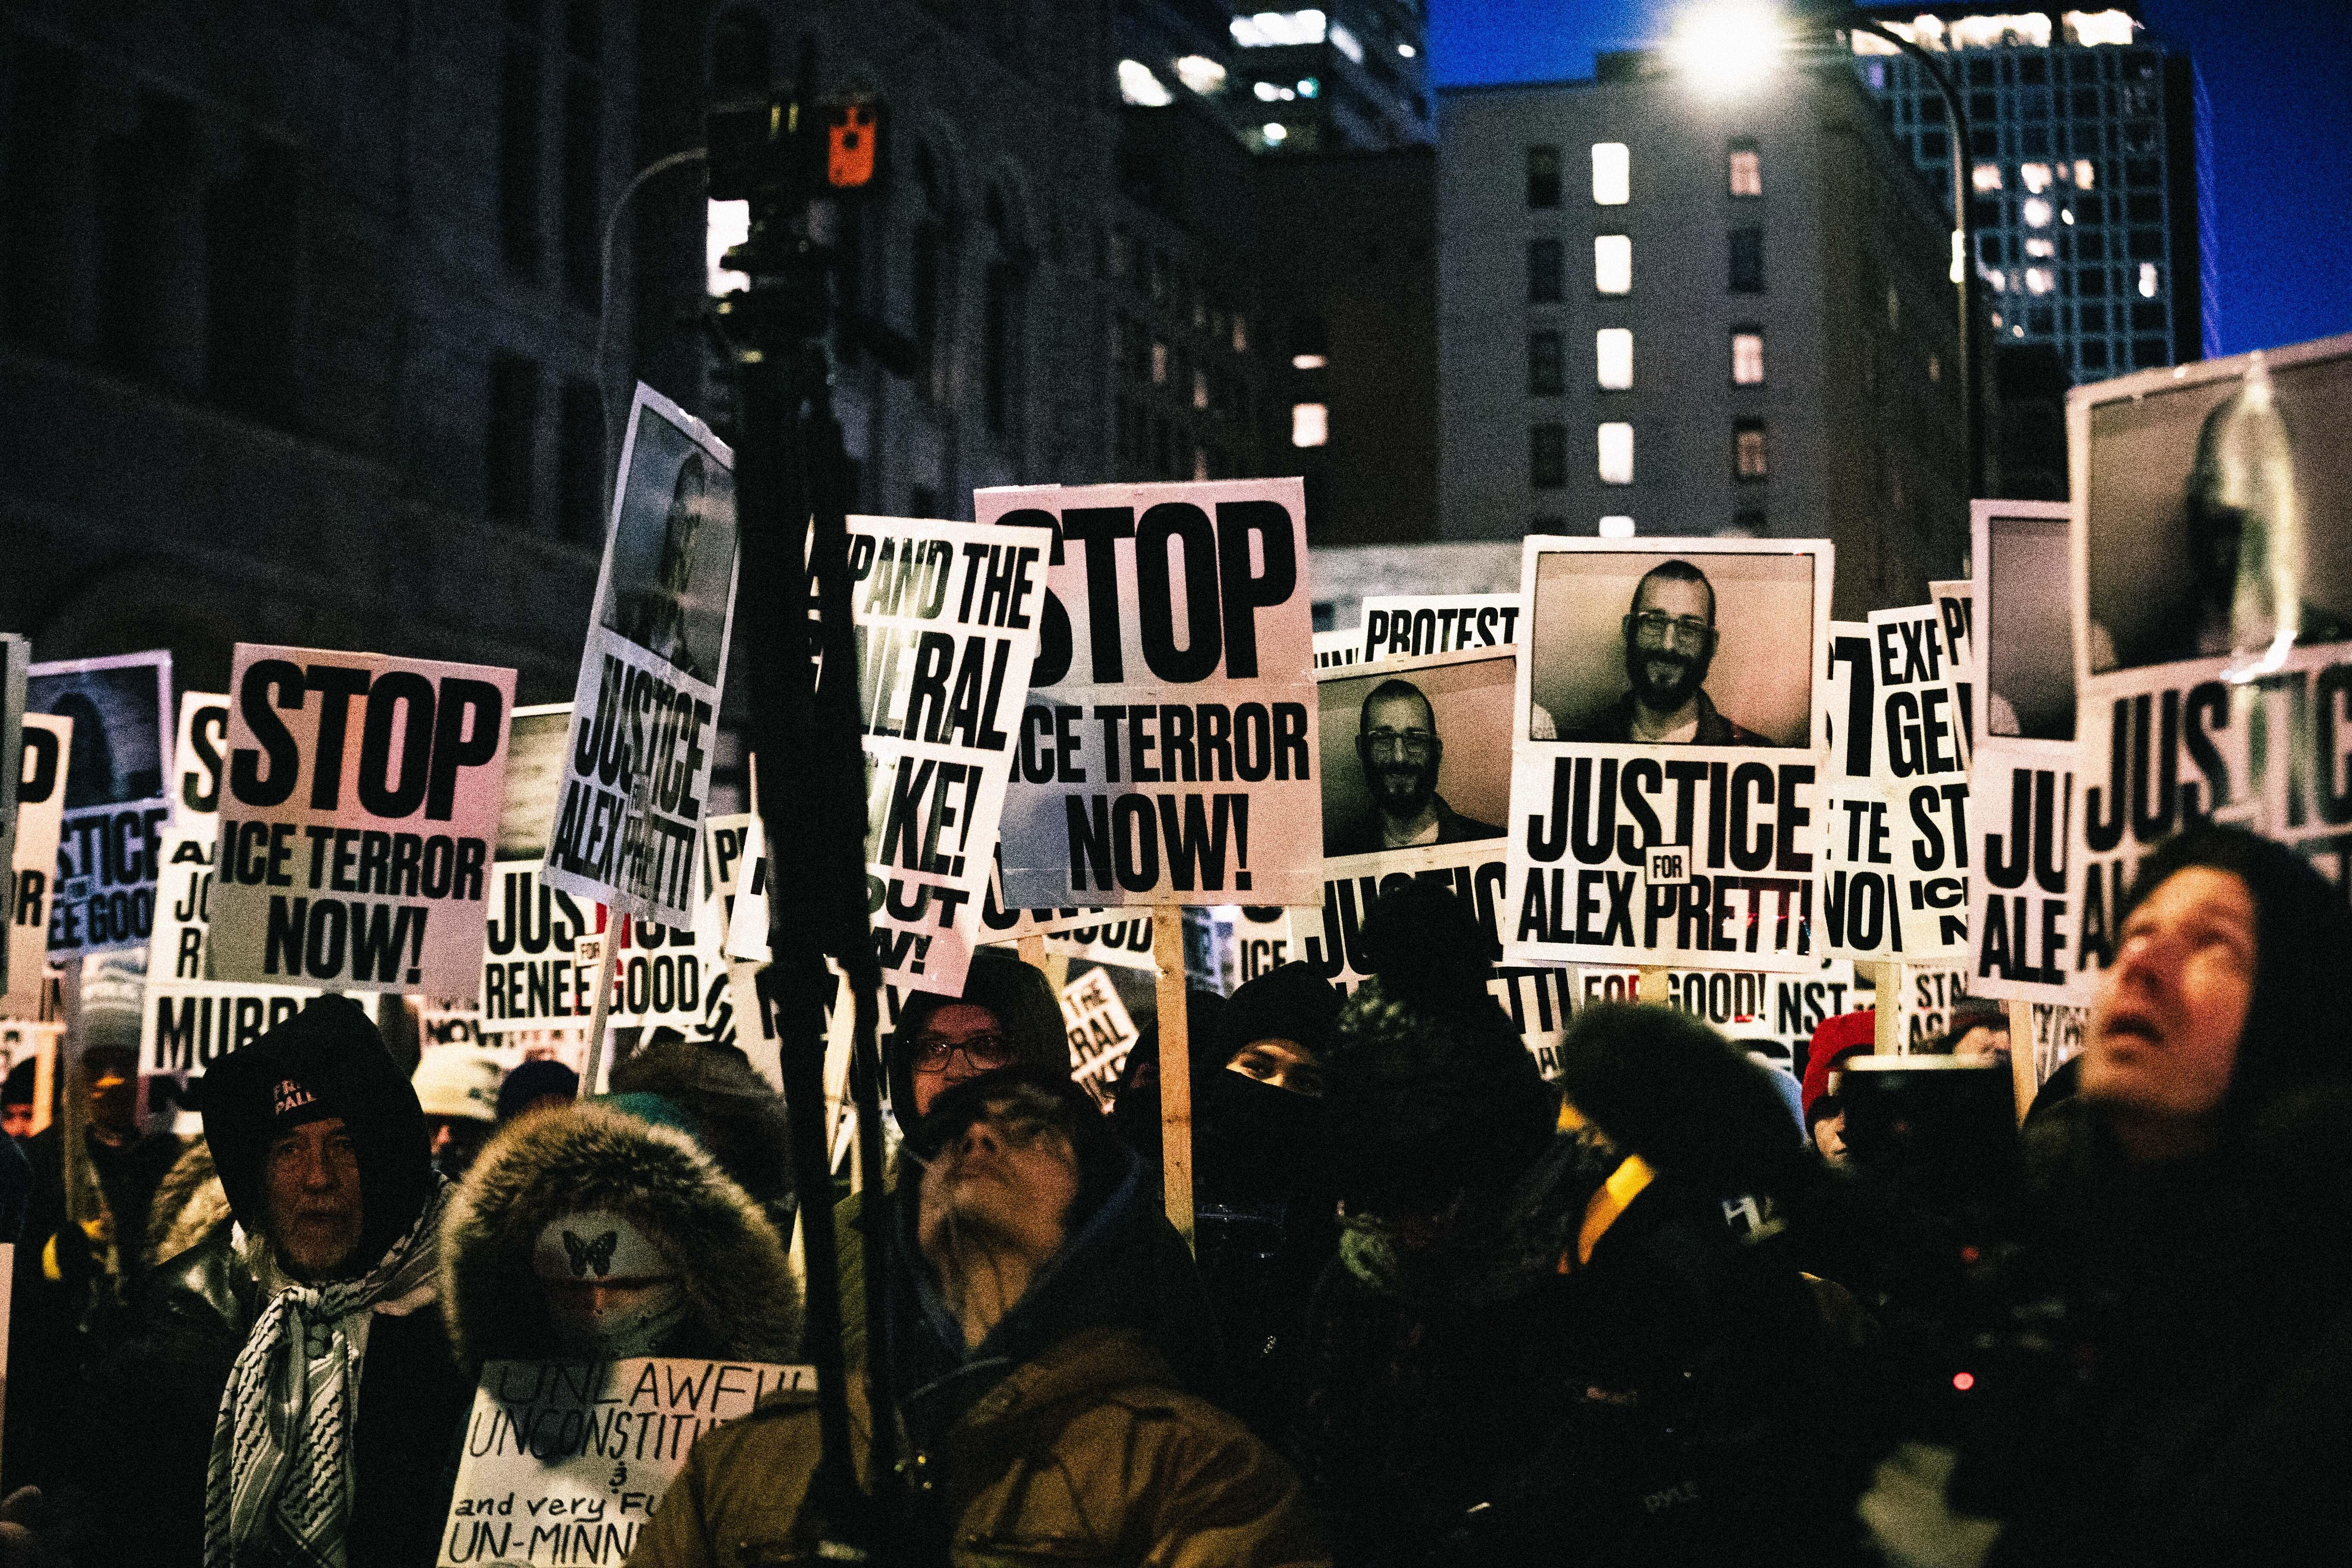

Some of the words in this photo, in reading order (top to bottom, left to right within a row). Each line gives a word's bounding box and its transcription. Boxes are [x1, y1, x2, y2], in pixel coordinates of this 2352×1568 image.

[846, 534, 953, 619] PAND
[958, 542, 1040, 630] THE
[1365, 607, 1519, 662] PROTEST
[230, 659, 502, 821] STOP
[575, 653, 713, 822] JUSTICE
[1008, 704, 1087, 784] CE
[1093, 702, 1310, 784] TERROR
[550, 779, 626, 888] ALEX
[1065, 793, 1253, 894] NOW!
[1526, 756, 1815, 873] JUSTICE
[220, 820, 297, 887] ICE
[306, 825, 487, 901] TERROR
[1652, 854, 1682, 879] FOR
[264, 895, 429, 985] NOW!
[1517, 867, 1636, 946] ALEX
[1643, 874, 1813, 956] PRETTI
[486, 959, 593, 1019] RENEE
[454, 1491, 515, 1516] and
[527, 1495, 606, 1522] very
